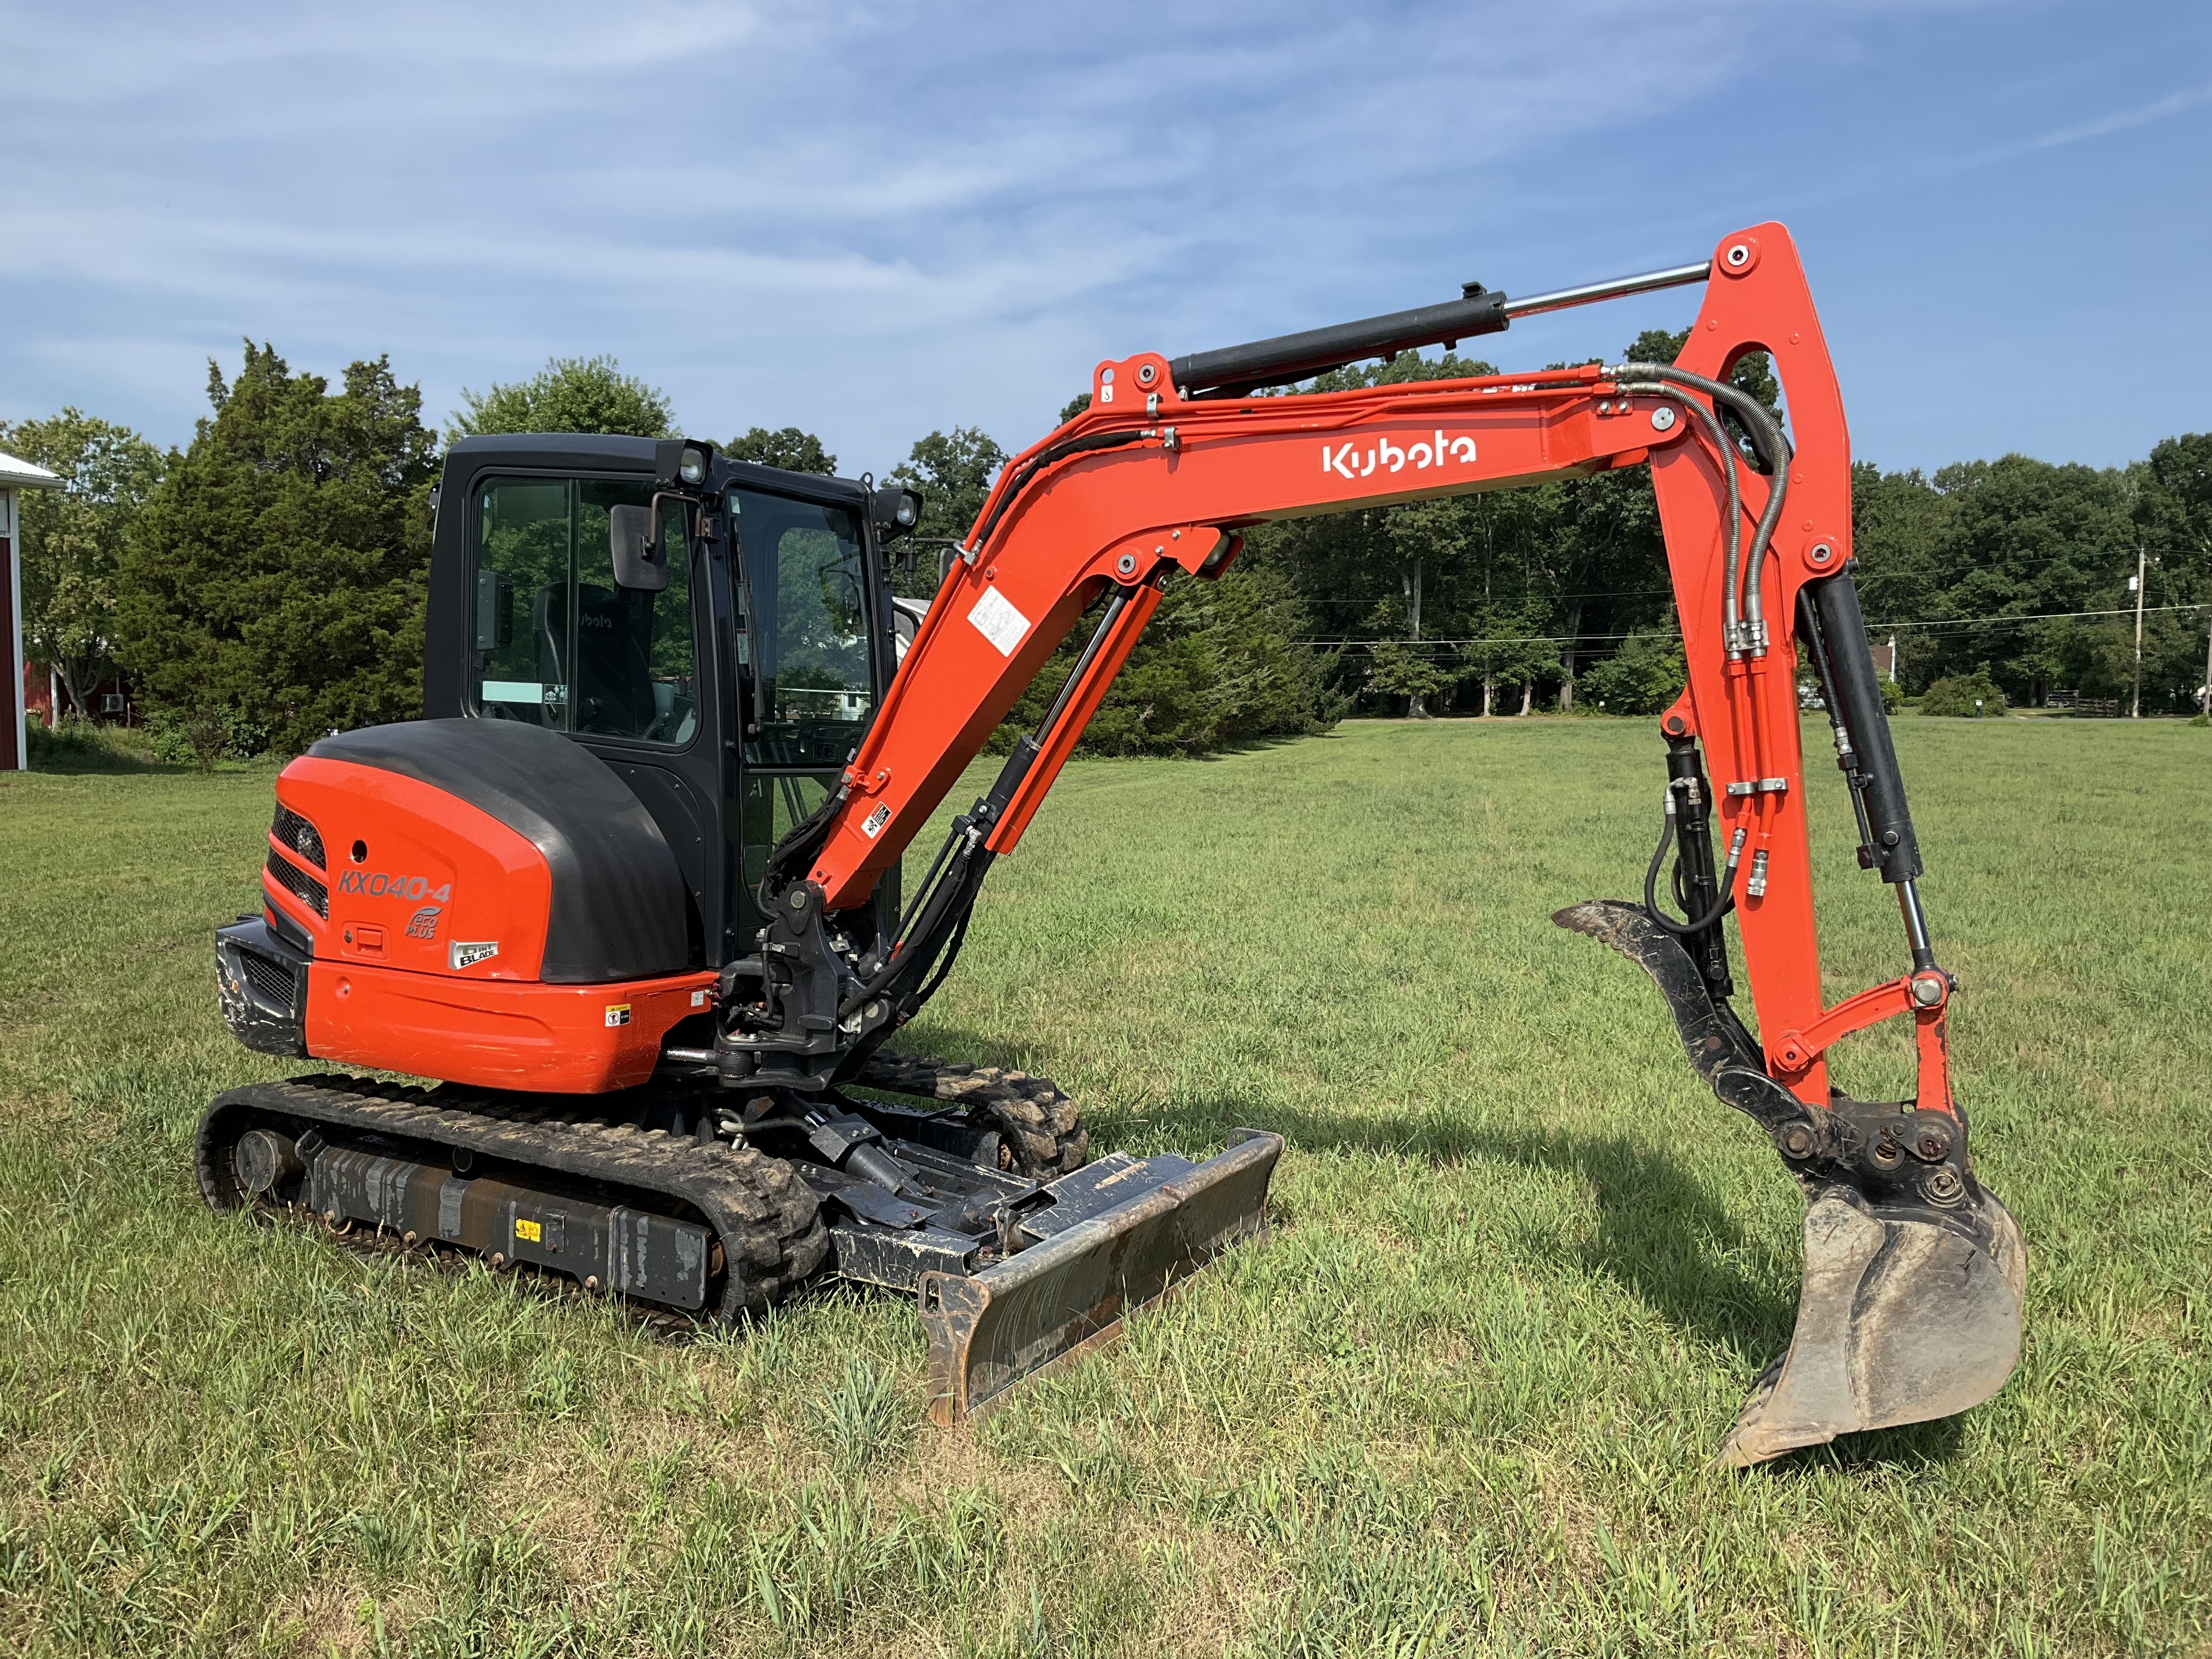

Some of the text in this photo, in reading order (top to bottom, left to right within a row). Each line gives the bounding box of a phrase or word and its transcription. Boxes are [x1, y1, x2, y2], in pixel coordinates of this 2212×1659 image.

[1323, 430, 1476, 478] Kubota
[578, 613, 612, 628] ubota
[337, 870, 451, 903] KX040-4
[415, 915, 438, 927] eco
[405, 925, 435, 939] PLUS
[460, 950, 495, 967] BLADE
